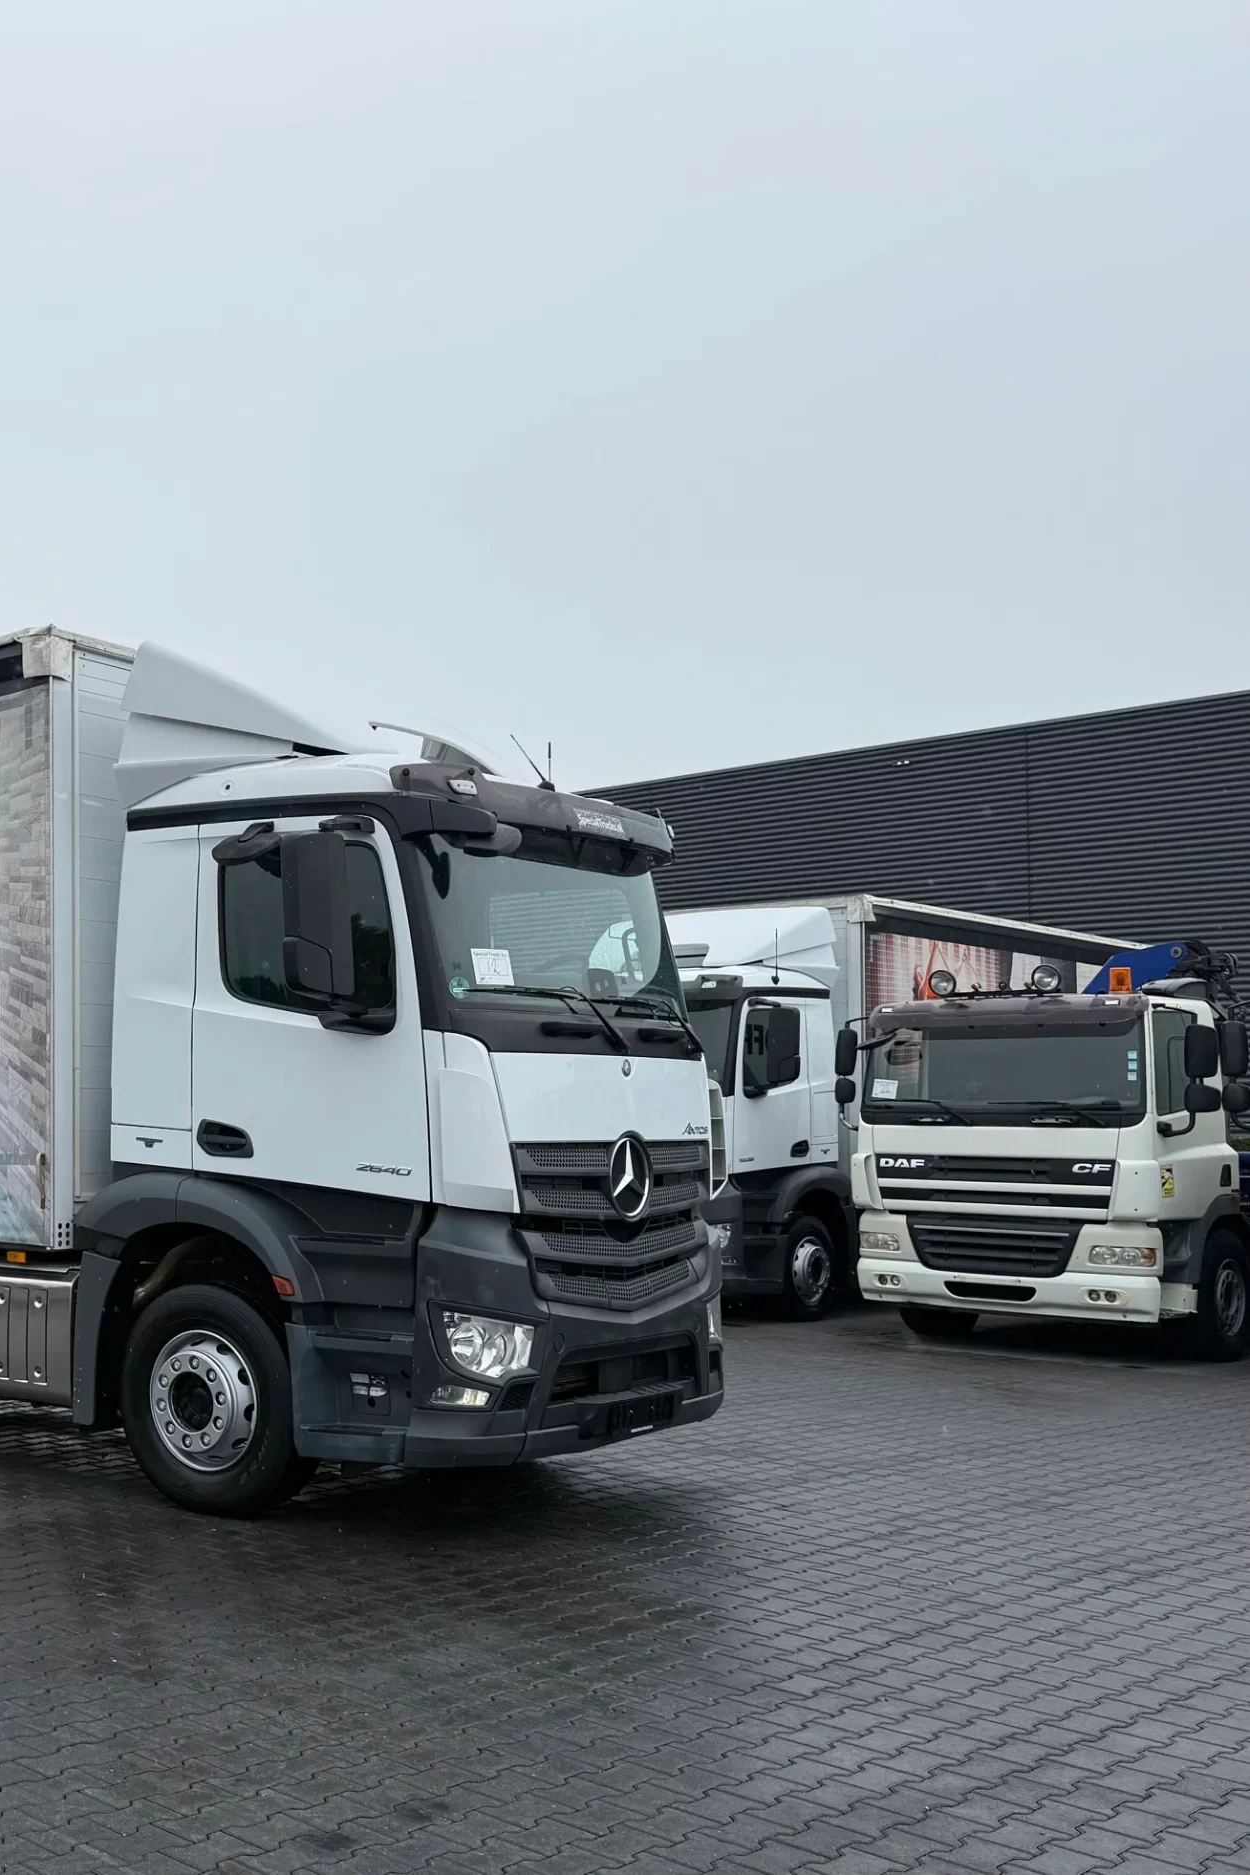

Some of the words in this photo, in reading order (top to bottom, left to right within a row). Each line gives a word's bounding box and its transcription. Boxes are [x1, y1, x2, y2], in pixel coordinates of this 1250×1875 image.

[355, 1162, 412, 1176] 2640
[879, 1157, 925, 1169] DAF
[1071, 1163, 1113, 1175] CF
